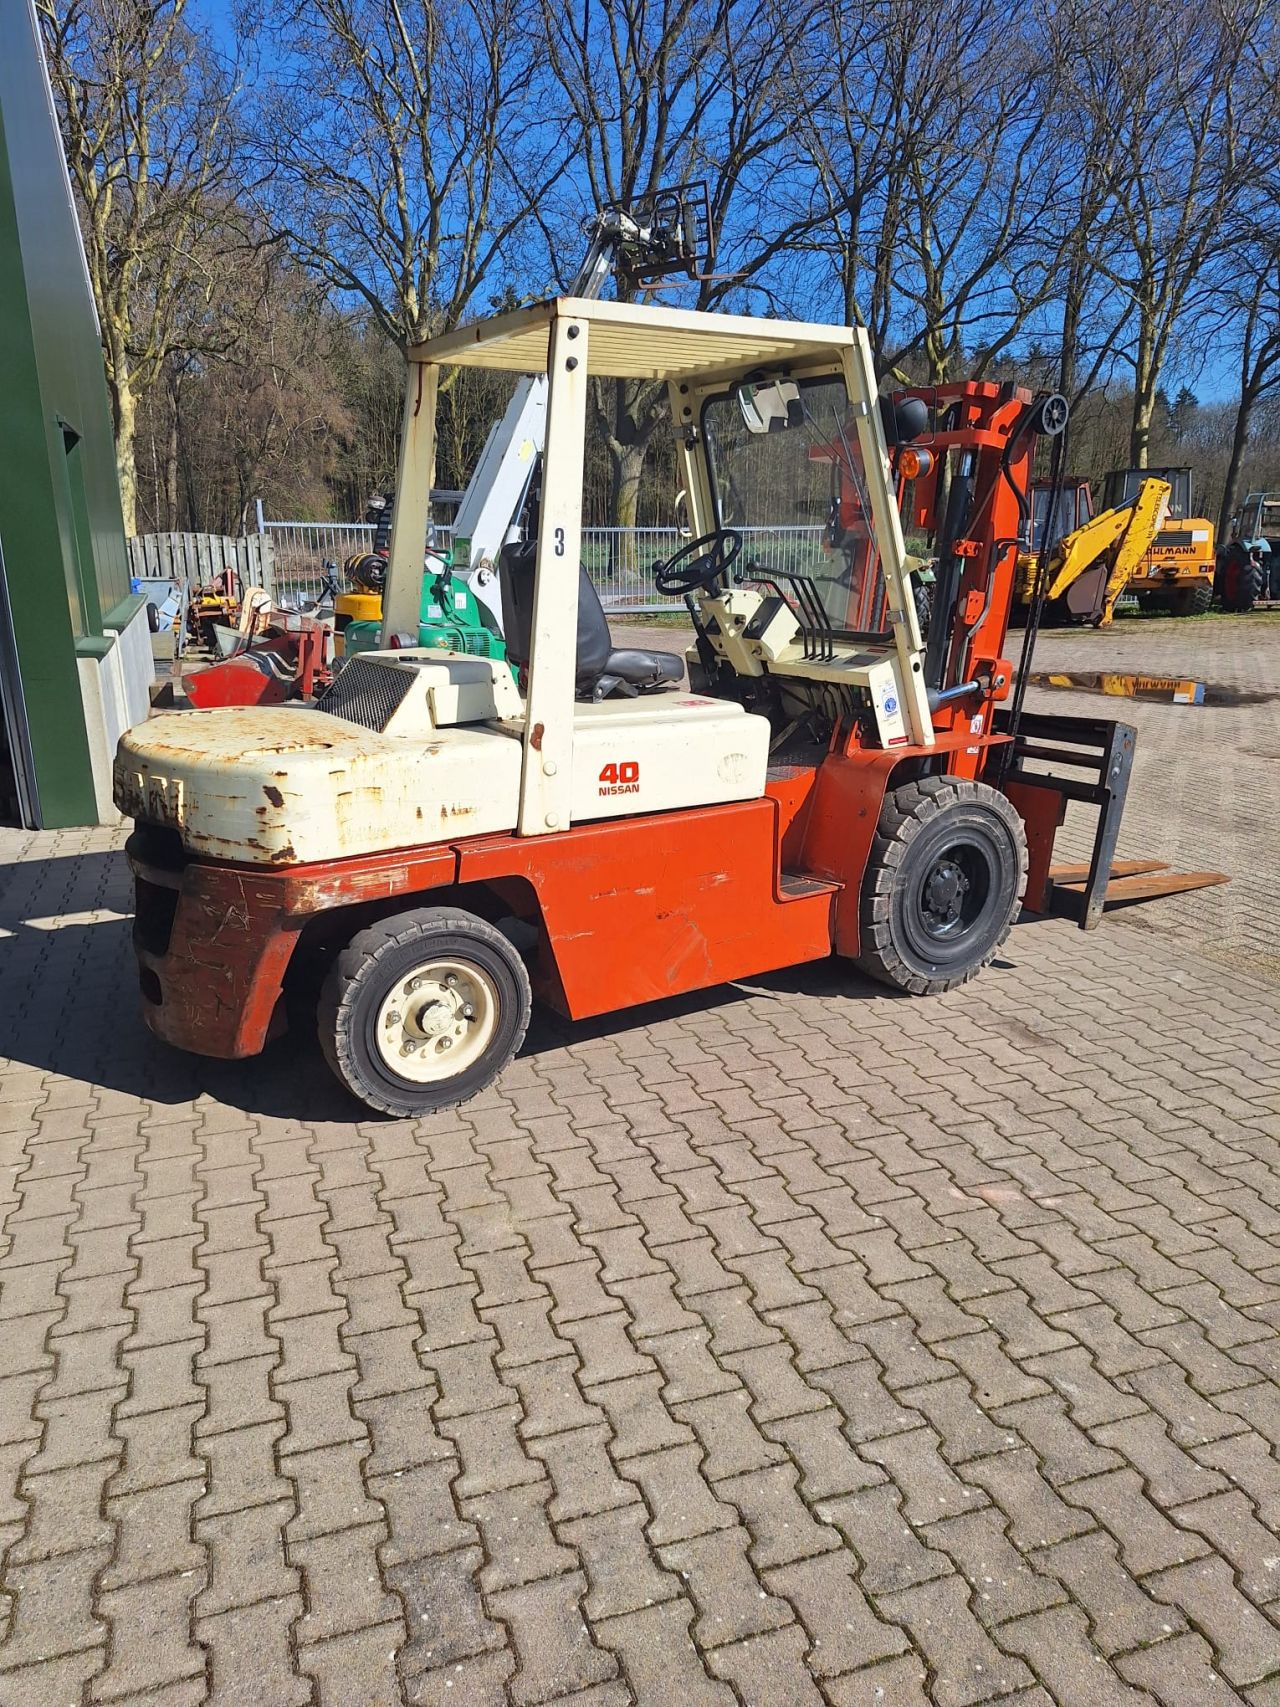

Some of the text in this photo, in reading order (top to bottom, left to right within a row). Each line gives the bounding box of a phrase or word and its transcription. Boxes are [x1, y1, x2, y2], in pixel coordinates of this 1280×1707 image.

[555, 527, 564, 557] 3
[599, 761, 639, 784] 40
[599, 784, 640, 796] NISSAN
